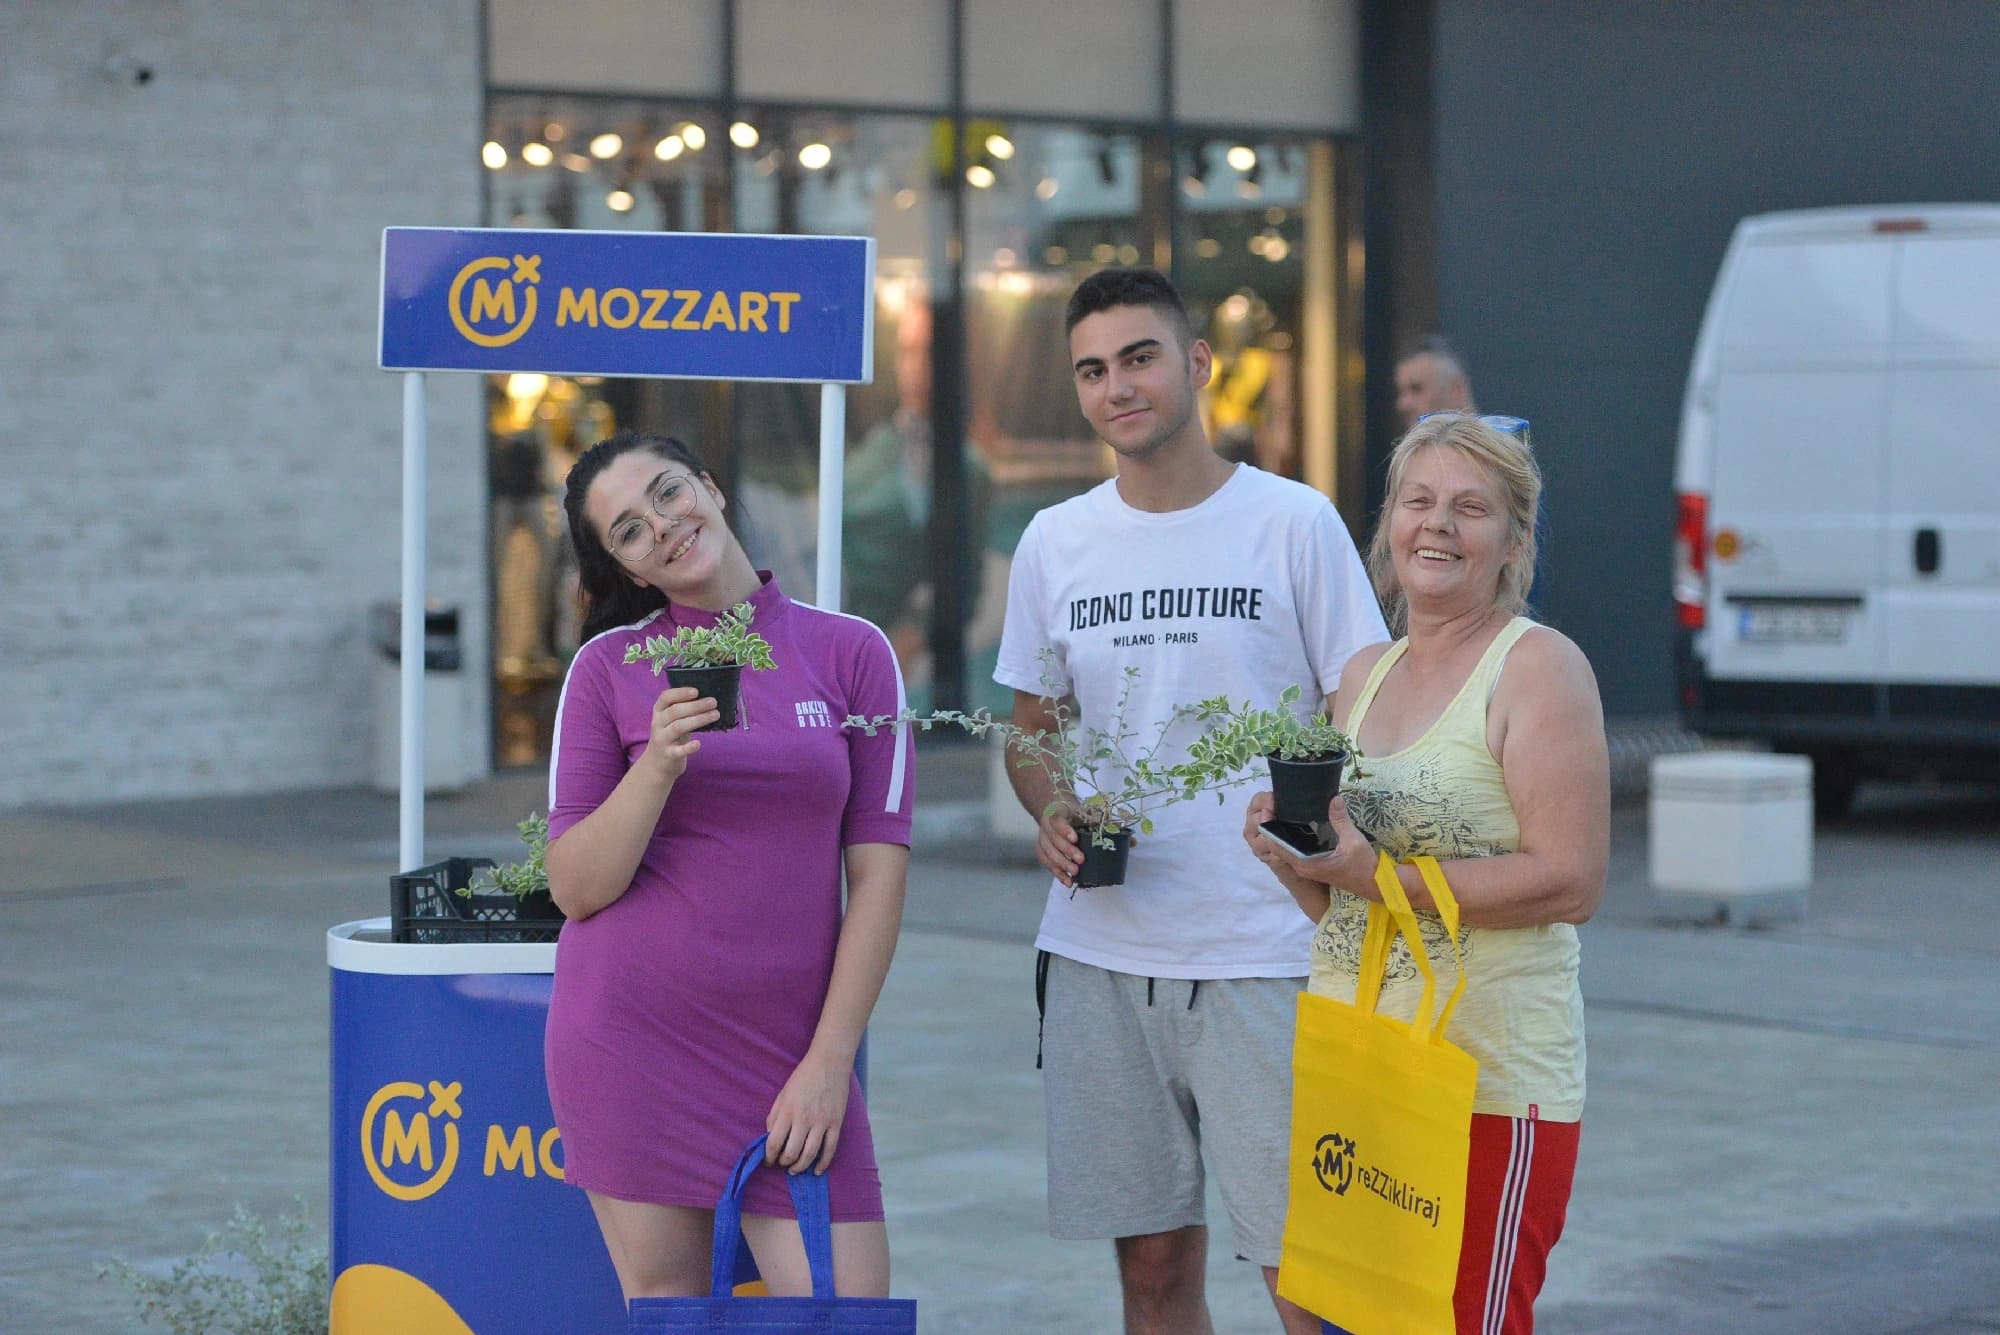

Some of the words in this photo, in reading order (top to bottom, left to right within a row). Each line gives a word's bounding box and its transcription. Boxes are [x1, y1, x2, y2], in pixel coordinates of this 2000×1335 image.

[556, 287, 800, 333] MOZZART
[1070, 592, 1132, 631] ICONO
[1142, 587, 1263, 621] COUTURE
[1114, 634, 1155, 648] MILANO
[1165, 632, 1199, 645] PARIS
[1358, 1166, 1440, 1227] reZZikliraj
